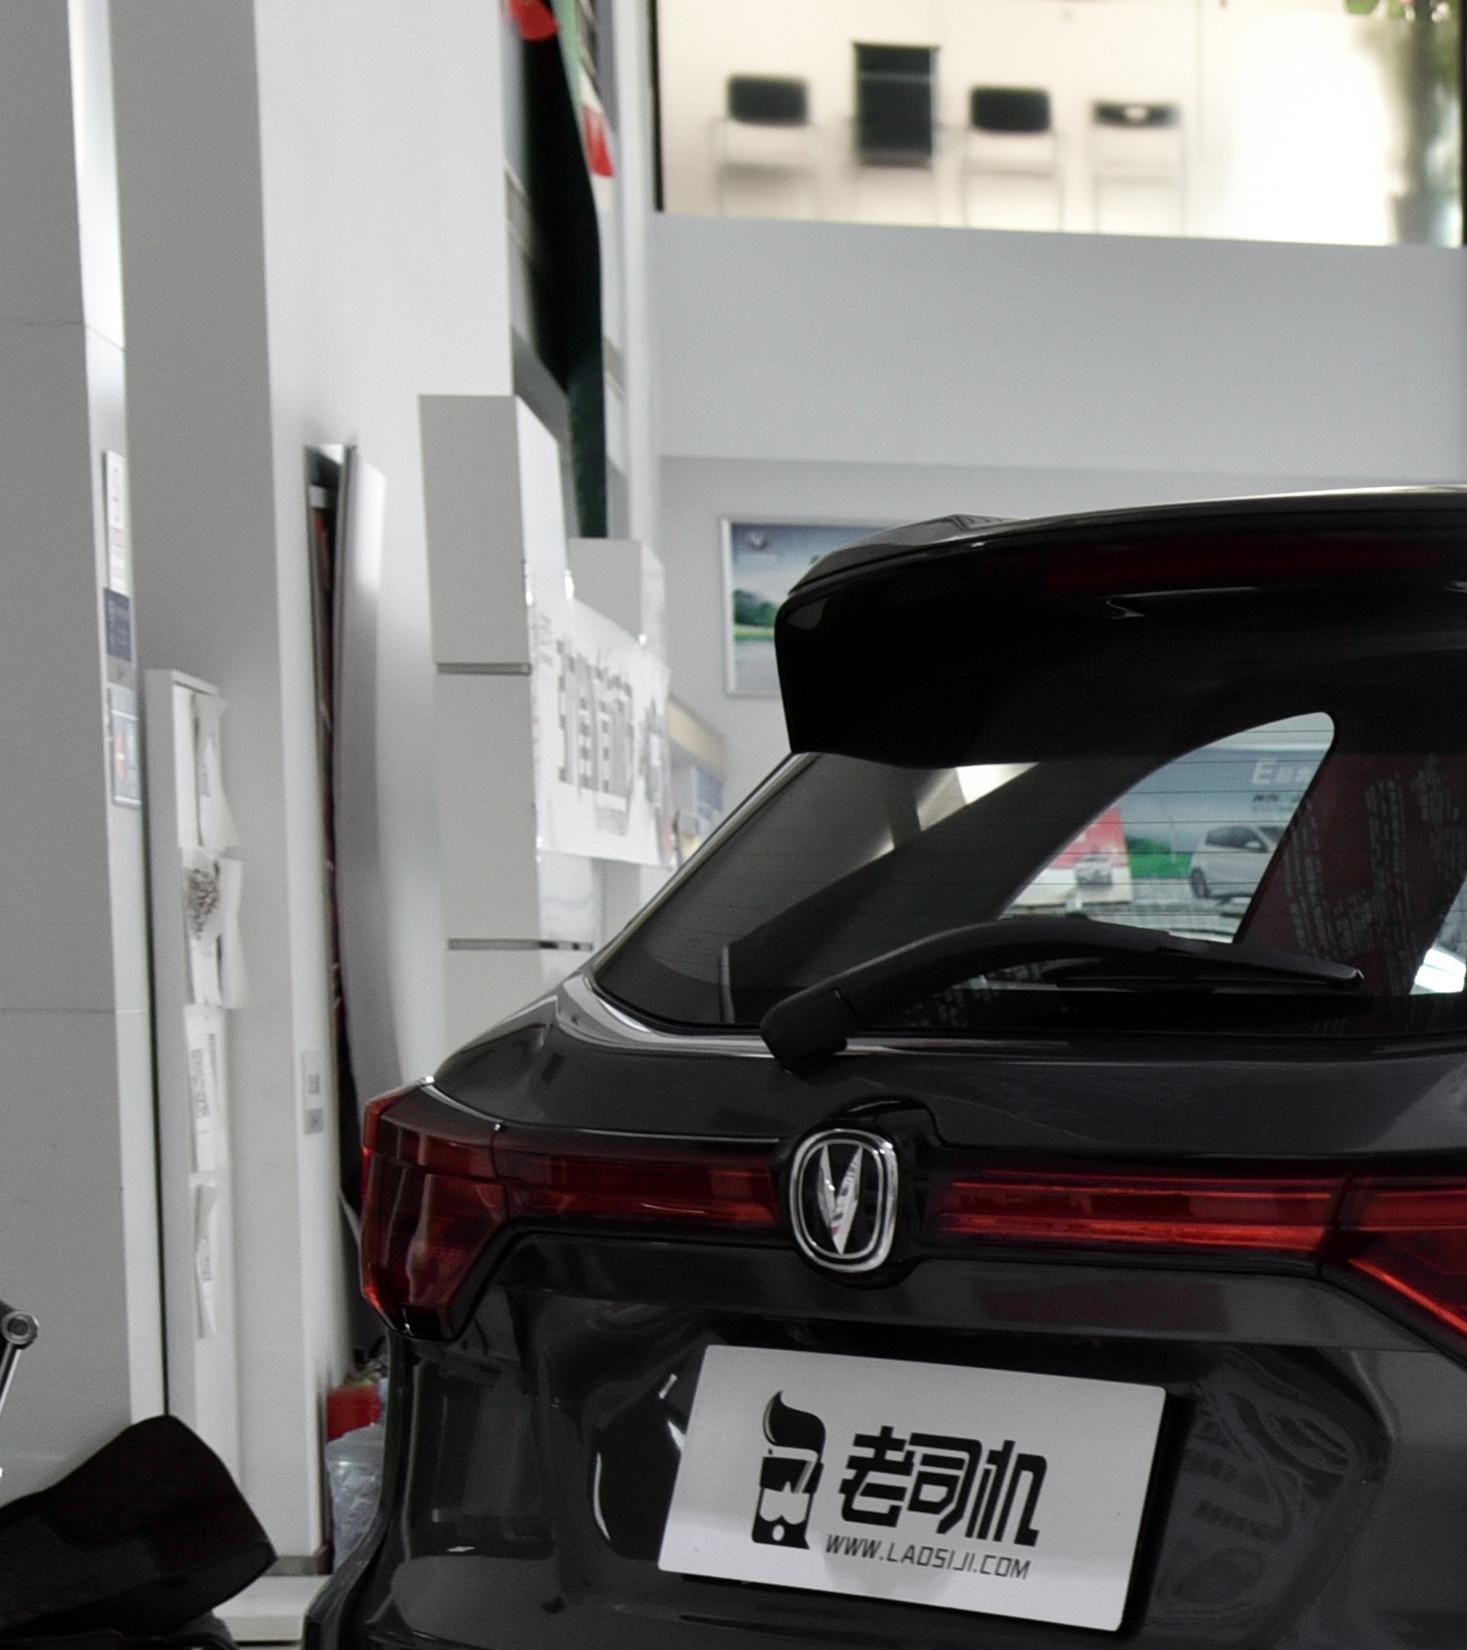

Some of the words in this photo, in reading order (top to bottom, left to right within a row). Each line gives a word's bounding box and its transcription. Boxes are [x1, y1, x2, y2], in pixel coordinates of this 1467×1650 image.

[838, 1424, 1048, 1547] 老司机
[824, 1534, 1031, 1580] WWW.LAOSIJI.COM
